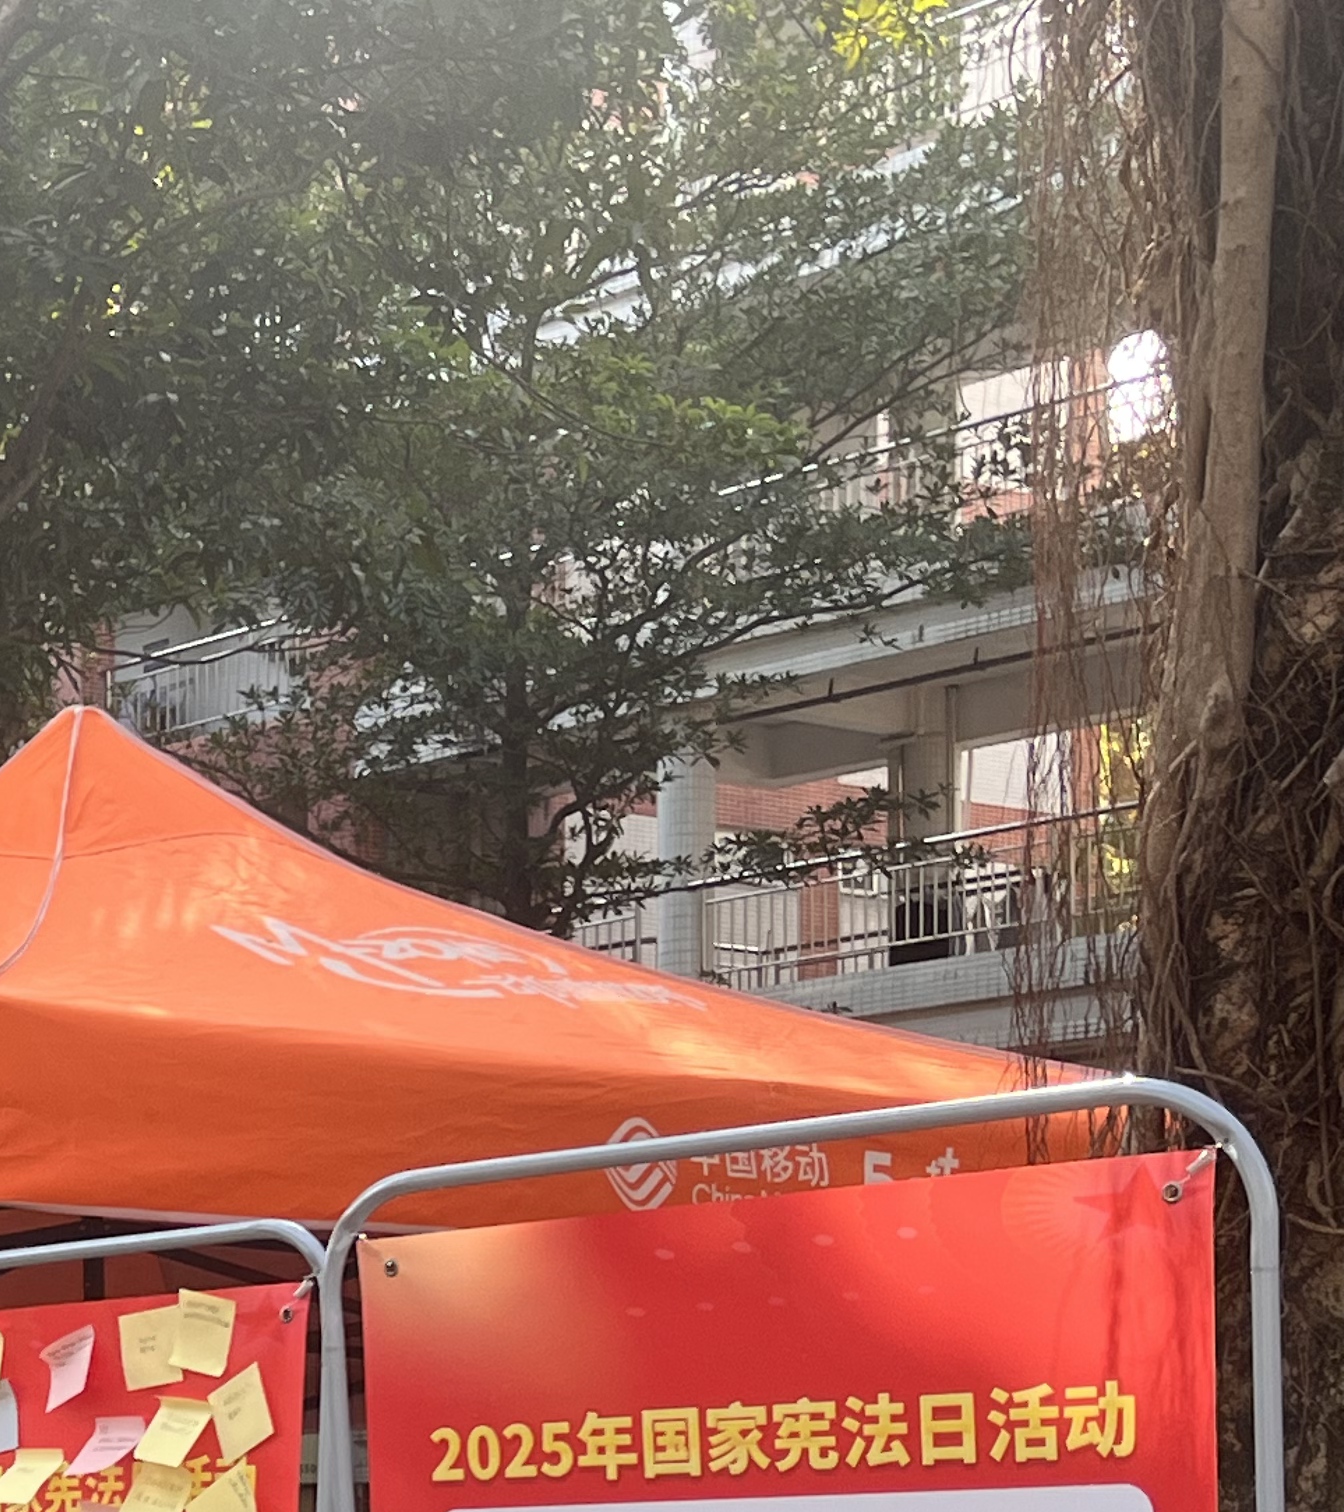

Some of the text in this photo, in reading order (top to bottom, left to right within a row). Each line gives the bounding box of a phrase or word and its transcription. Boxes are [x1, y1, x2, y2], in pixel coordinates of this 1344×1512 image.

[690, 1143, 829, 1187] 中国移动
[429, 1381, 1137, 1484] 2025年国家宪法日活动
